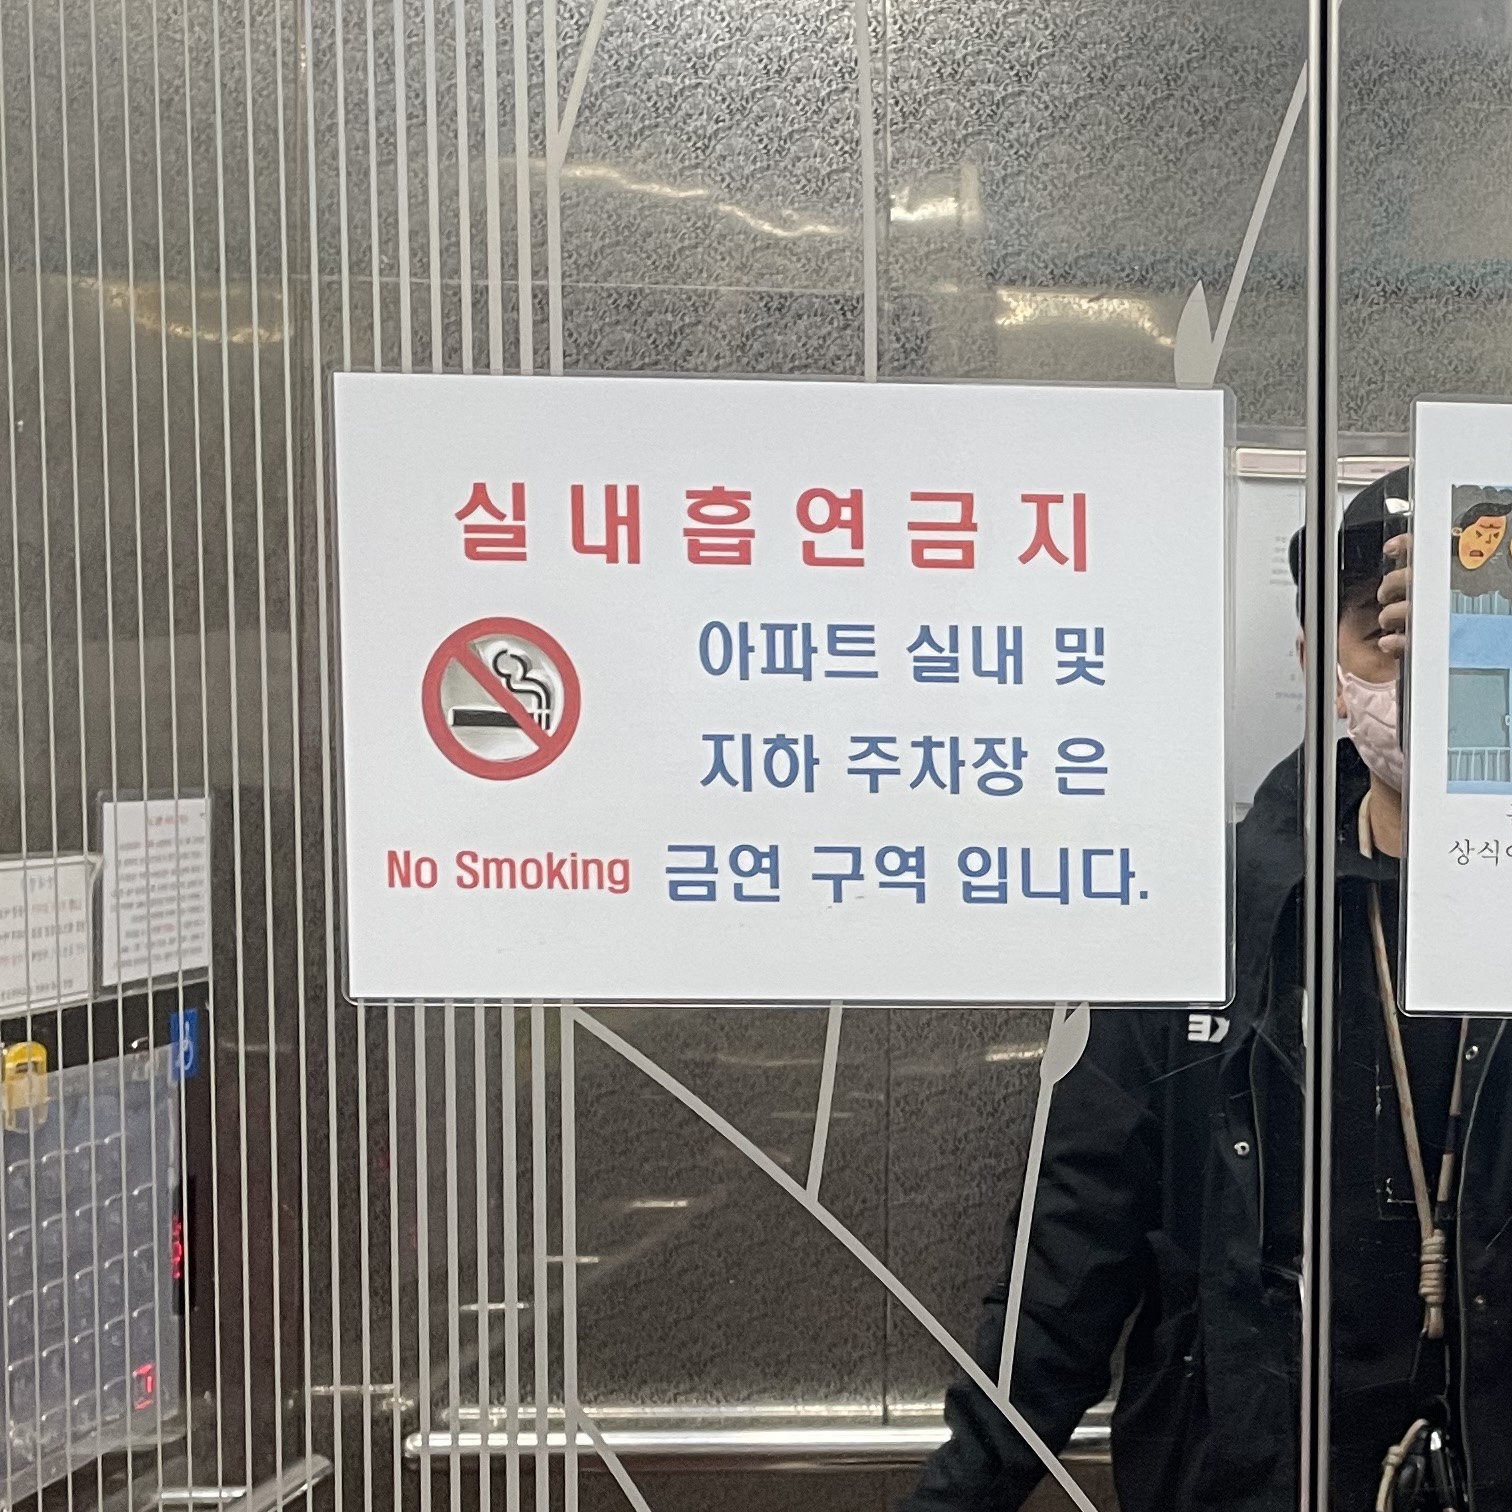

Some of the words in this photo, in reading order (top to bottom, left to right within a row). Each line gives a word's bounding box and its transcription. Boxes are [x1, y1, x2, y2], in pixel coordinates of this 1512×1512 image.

[699, 621, 878, 681] 아파트
[906, 625, 1023, 685] 실내
[1056, 627, 1105, 686] 및
[700, 733, 820, 793] 지하
[847, 736, 1028, 796] 주차장
[1055, 737, 1108, 795] 은
[387, 850, 438, 888] No
[456, 851, 630, 894] Smoking
[665, 844, 780, 902] 금연
[812, 846, 925, 904] 구역
[958, 846, 1148, 905] 입니다.
